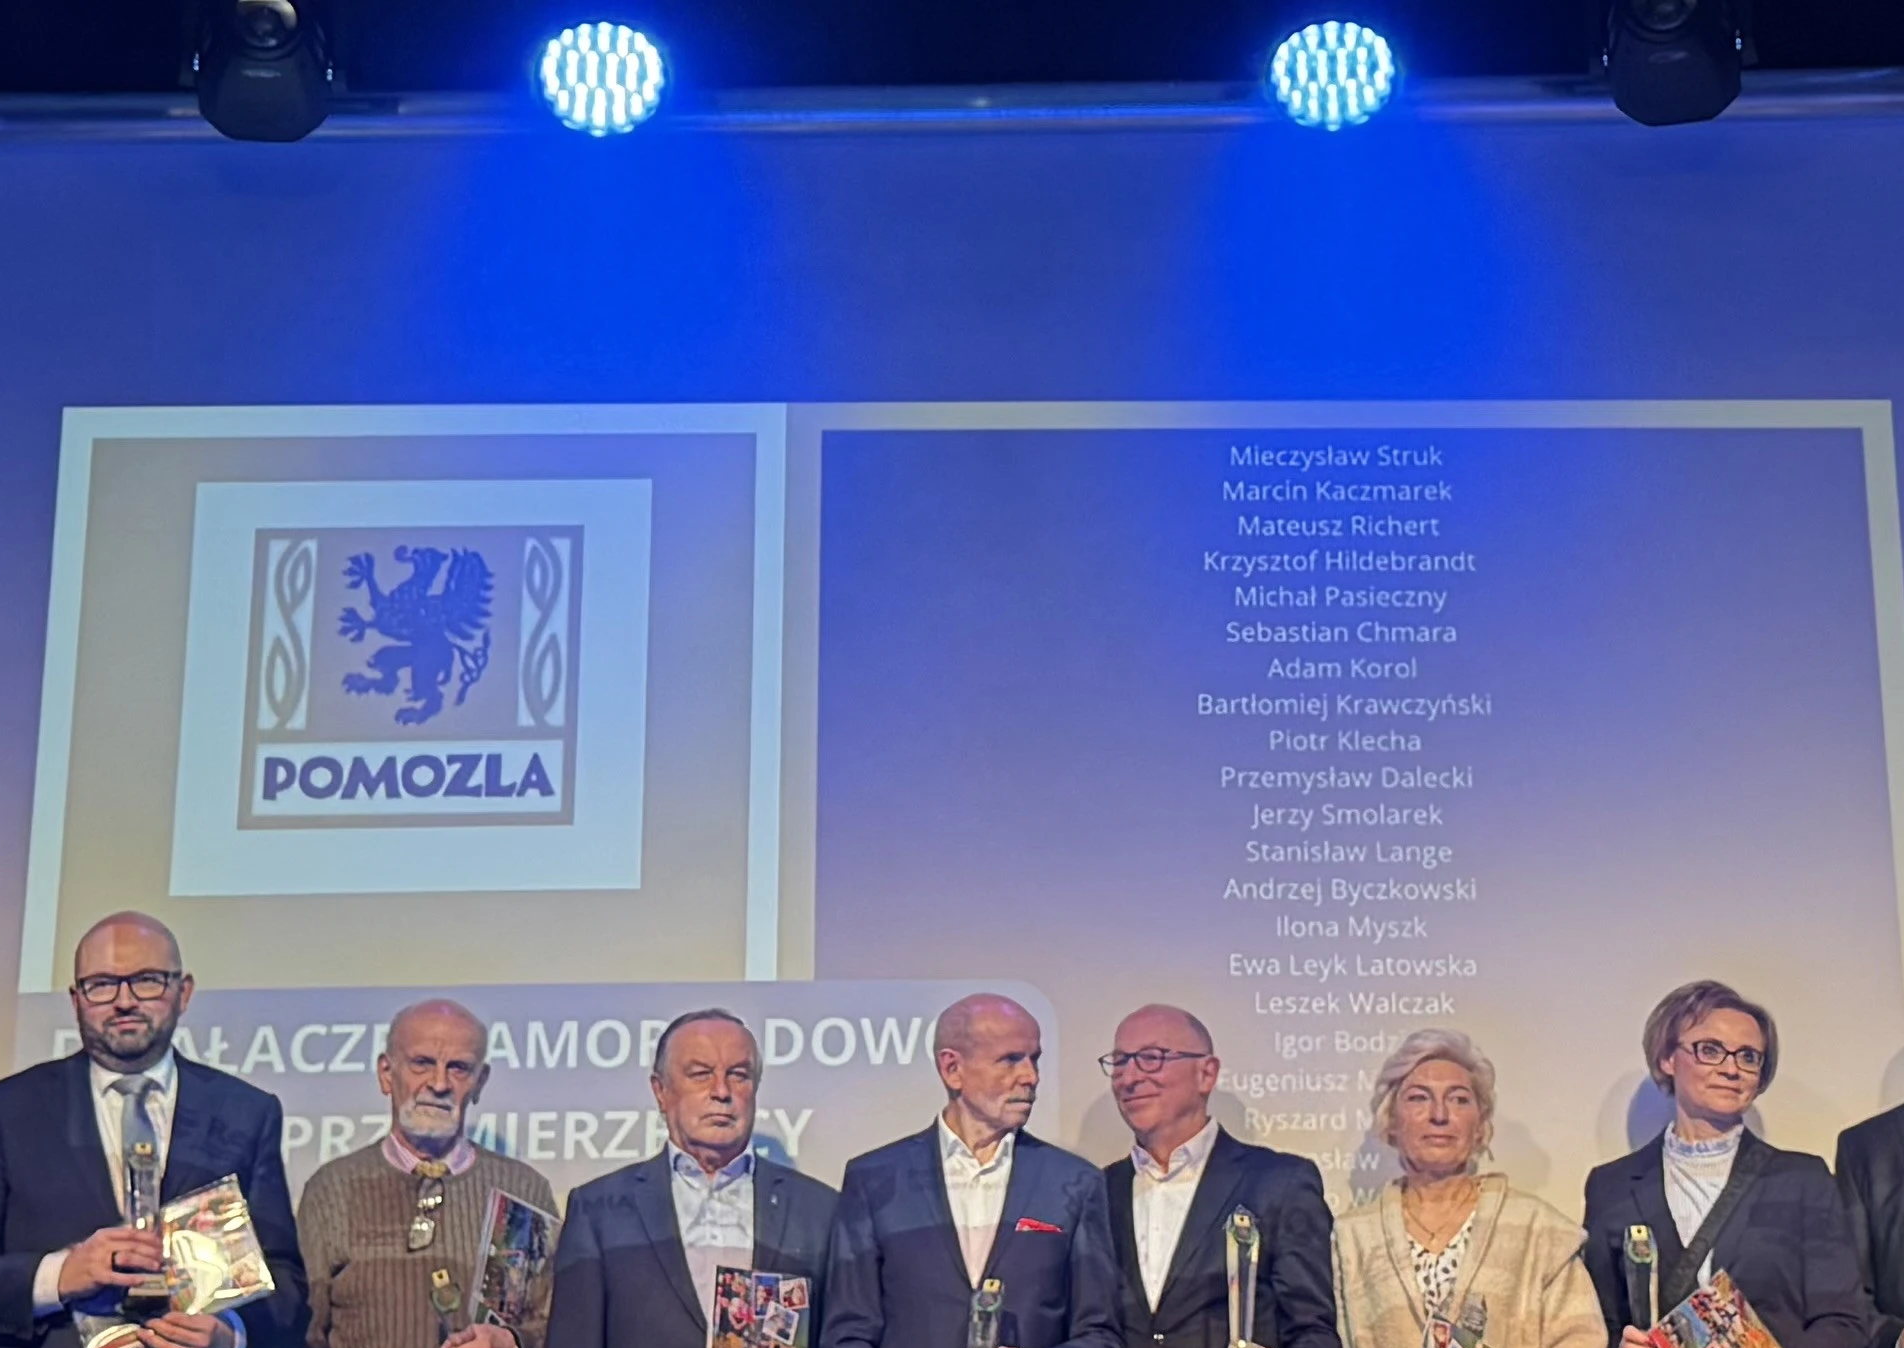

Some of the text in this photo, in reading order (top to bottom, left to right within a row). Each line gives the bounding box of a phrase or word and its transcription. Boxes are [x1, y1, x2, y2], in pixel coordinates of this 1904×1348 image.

[1230, 446, 1442, 471] Mieczysław Struk
[1223, 481, 1452, 501] Marcin Kaczmarek
[1237, 516, 1439, 536] Mateusz Richert
[1204, 550, 1476, 577] Krzysztof Hildebrandt
[1235, 587, 1447, 613] Michał Pasieczny
[1226, 622, 1456, 643] Sebastian Chmara
[1268, 659, 1417, 678] Adam Korol
[1198, 693, 1492, 721] Bartłomiej Krawczyński
[1269, 731, 1421, 751] Piotr Klecha
[261, 752, 555, 800] POMOZLA
[1221, 766, 1473, 793] Przemysław Dalecki
[1251, 804, 1442, 831] Jerzy Smolarek
[1246, 842, 1452, 869] Stanisław Lange
[1224, 878, 1476, 906] Andrzej Byczkowski
[1277, 917, 1427, 943] Ilona Myszk
[1230, 954, 1476, 982] Ewa Leyk Latowska
[1255, 992, 1454, 1014] Leszek Walczak
[53, 1023, 391, 1078] DAŁACZ
[1275, 1032, 1325, 1059] Igor
[1217, 1068, 1348, 1097] Eugeniusz
[1245, 1108, 1346, 1137] Ryszard
